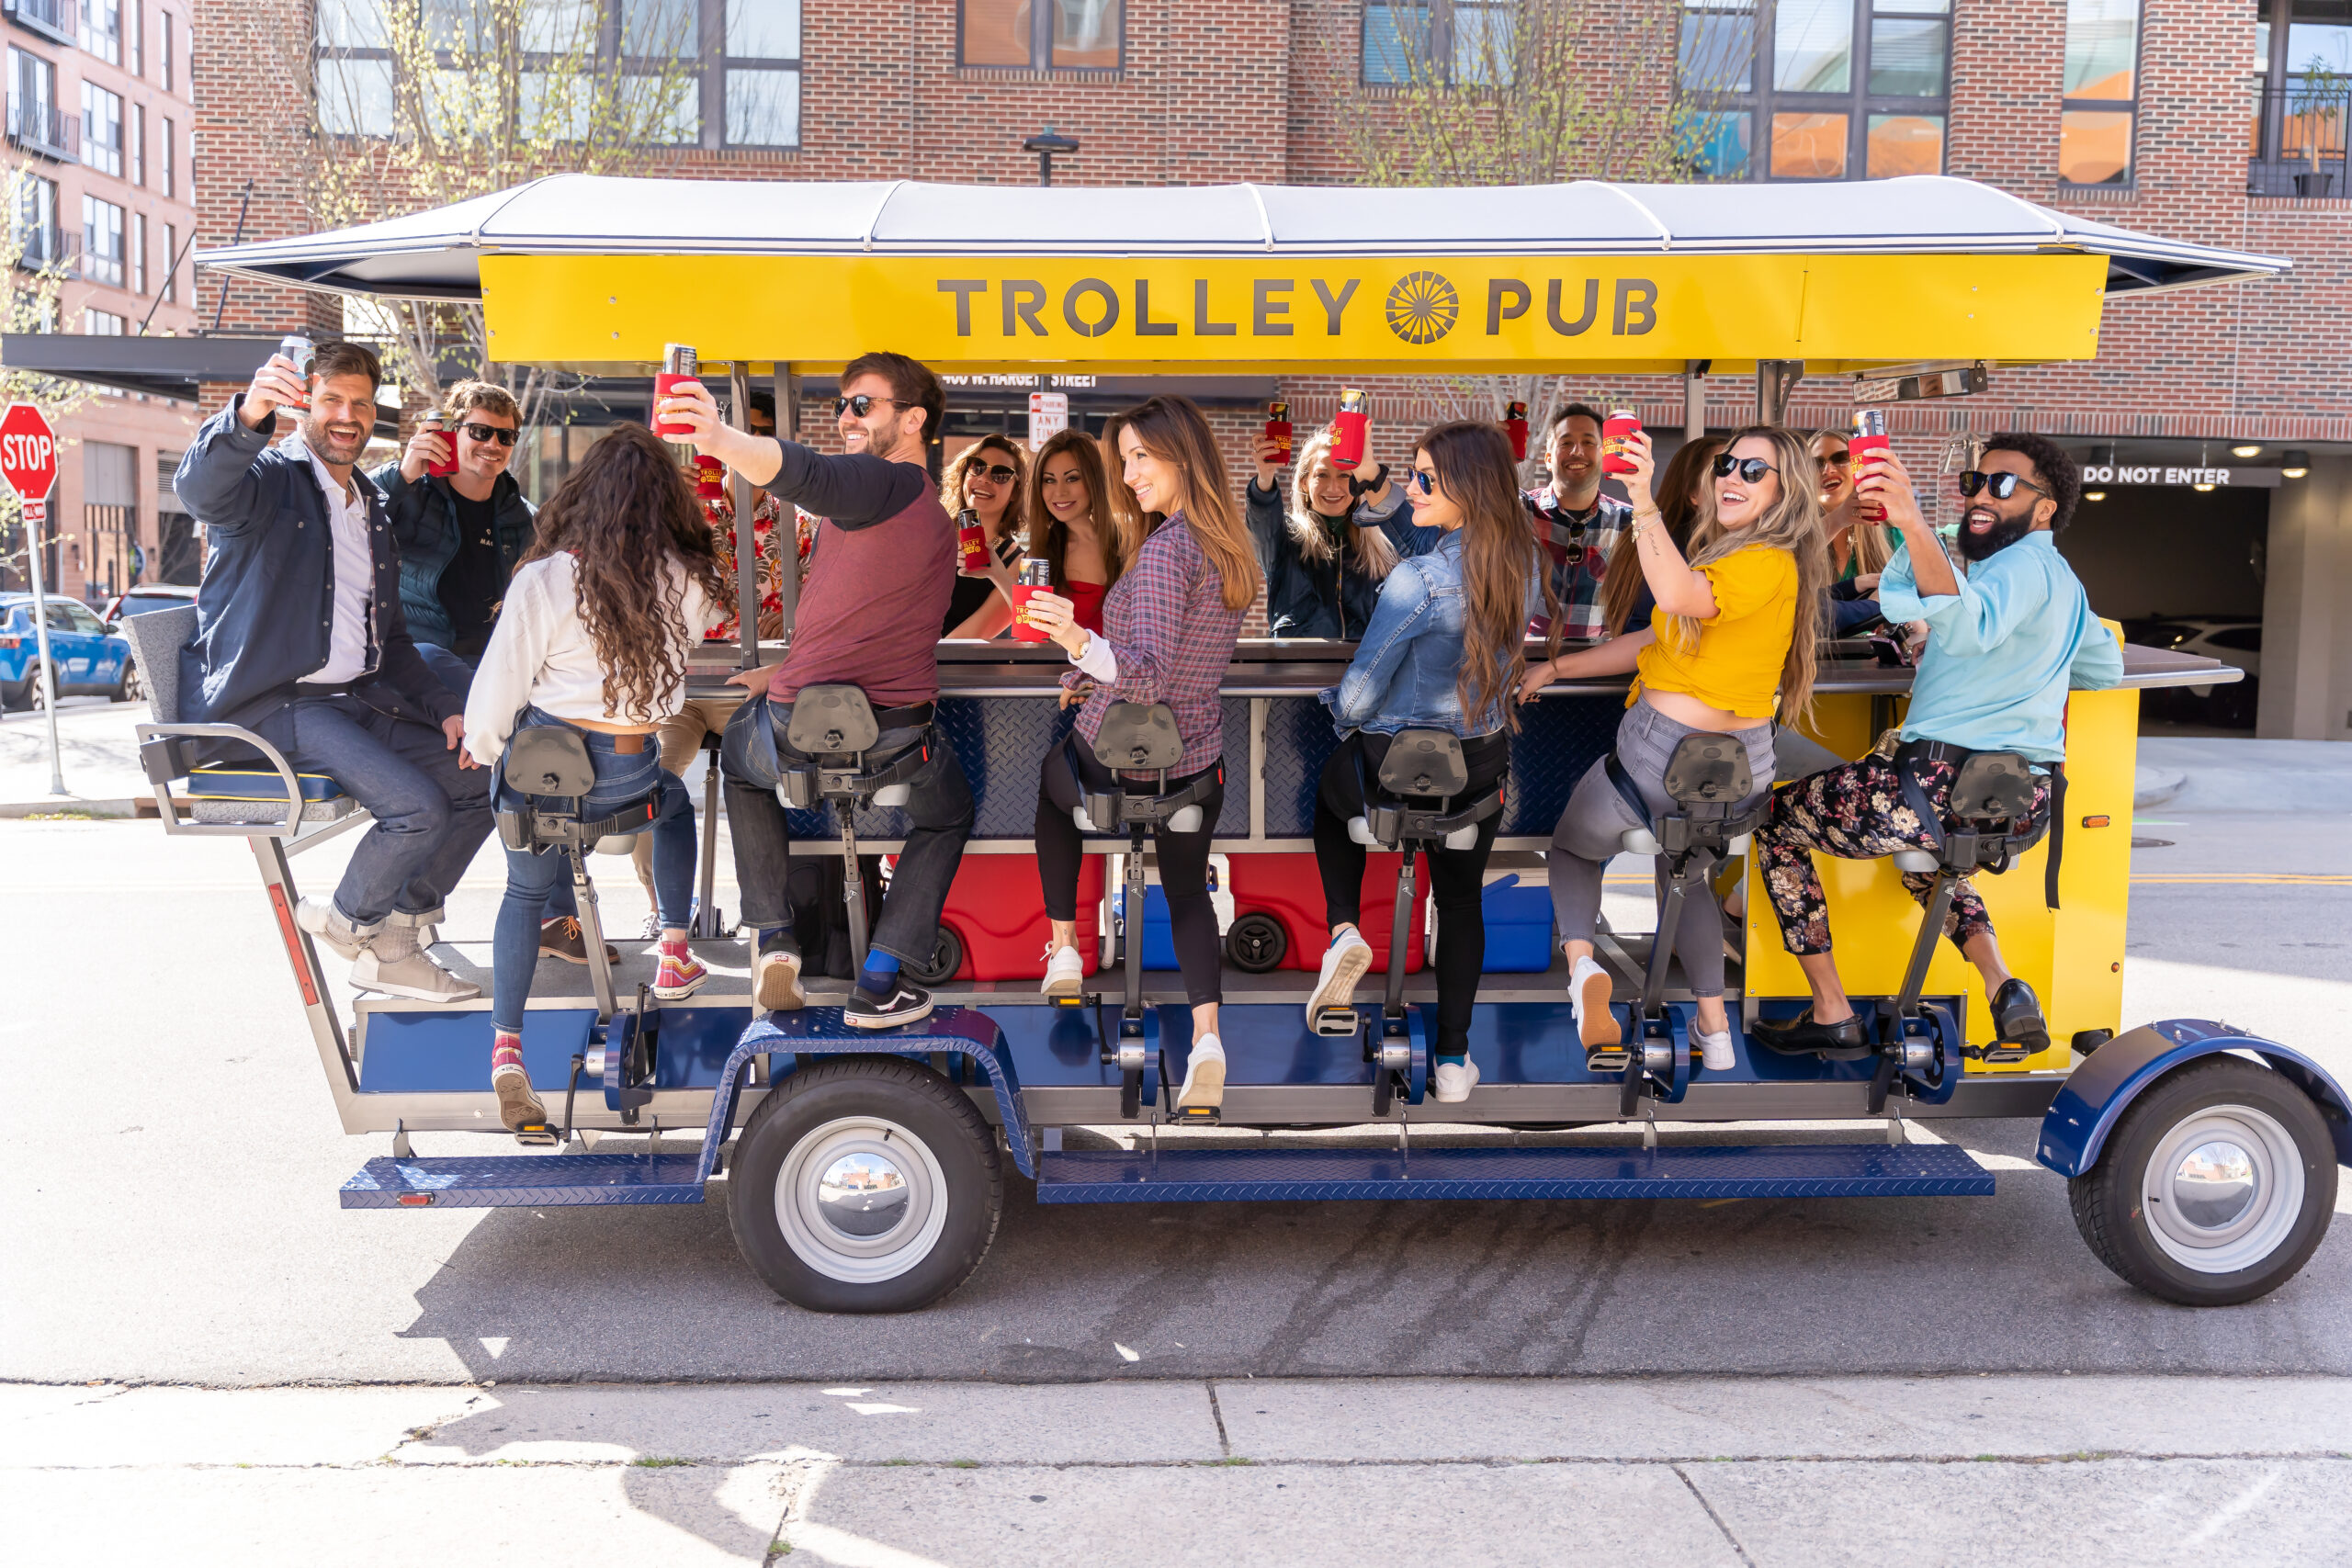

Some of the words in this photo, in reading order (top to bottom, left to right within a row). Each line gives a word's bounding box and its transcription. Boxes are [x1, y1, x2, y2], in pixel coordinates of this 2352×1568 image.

[936, 277, 1362, 338] TROLLEY
[1486, 278, 1658, 337] PUB
[1050, 376, 1096, 388] STREET
[1037, 416, 1059, 425] ANY
[1036, 428, 1059, 439] TIM
[3, 434, 52, 470] STOP
[2083, 466, 2113, 483] DO
[2118, 467, 2161, 484] NOT
[2165, 468, 2231, 485] ENTER
